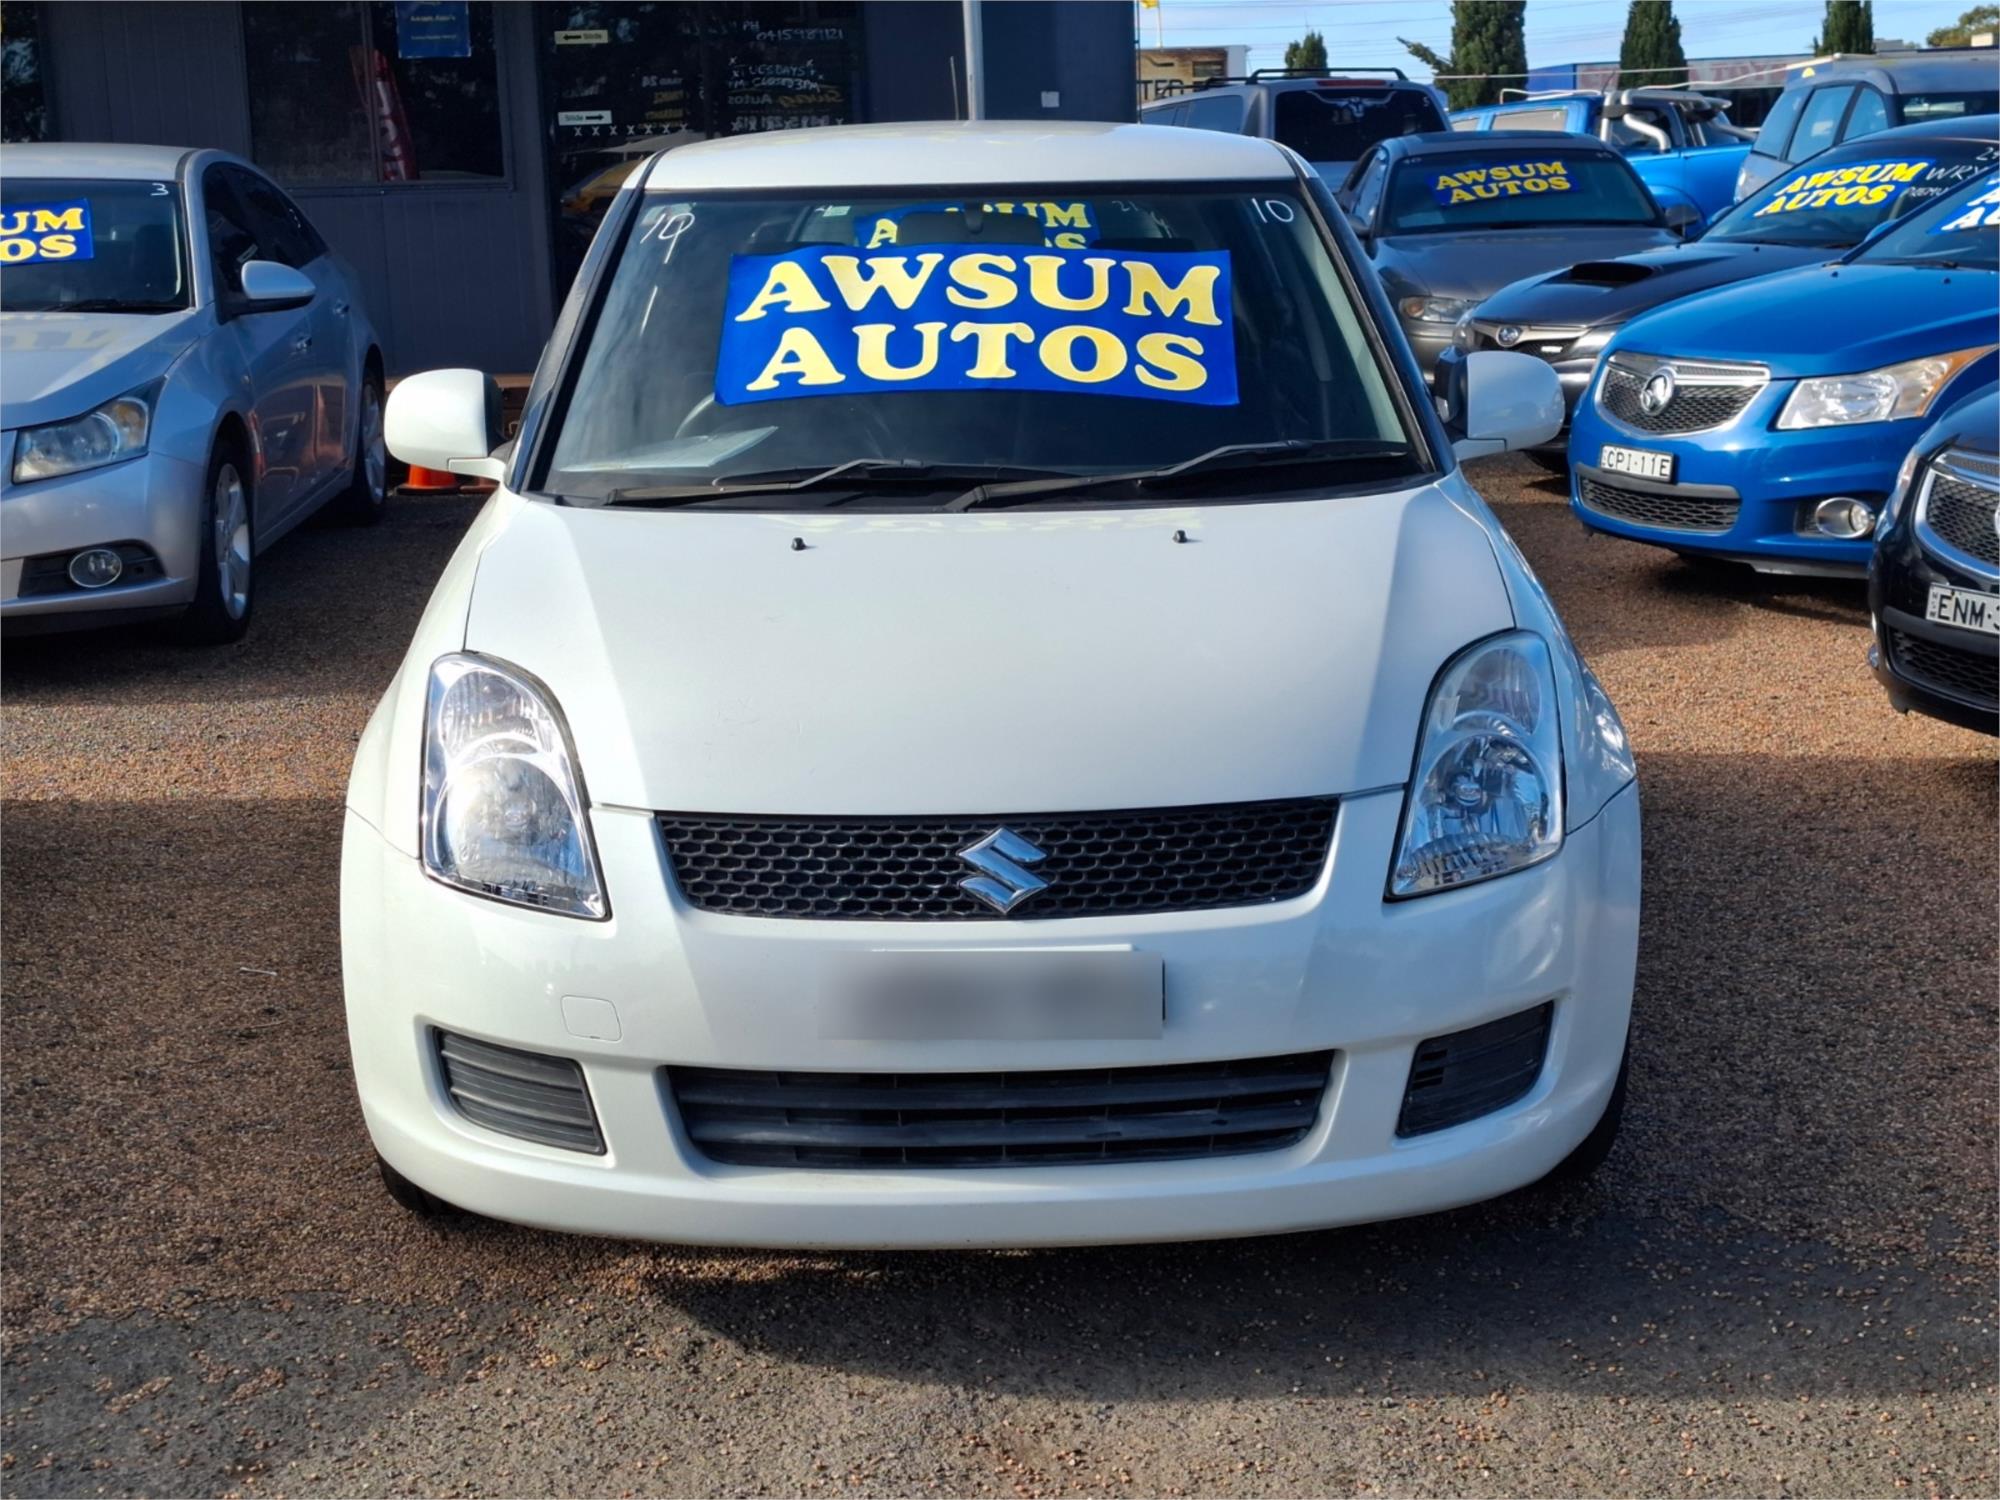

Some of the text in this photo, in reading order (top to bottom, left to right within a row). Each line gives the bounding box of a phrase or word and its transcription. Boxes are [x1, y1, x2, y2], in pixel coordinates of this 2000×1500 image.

[150, 183, 169, 196] 3
[1436, 161, 1568, 190] AWSUM
[1450, 176, 1571, 204] AUTOS
[1774, 162, 1929, 196] AWSUM
[1252, 198, 1294, 223] 10
[1753, 184, 1895, 217] AUTOS
[735, 252, 1222, 327] AWSUM
[746, 321, 1209, 392] AUTOS
